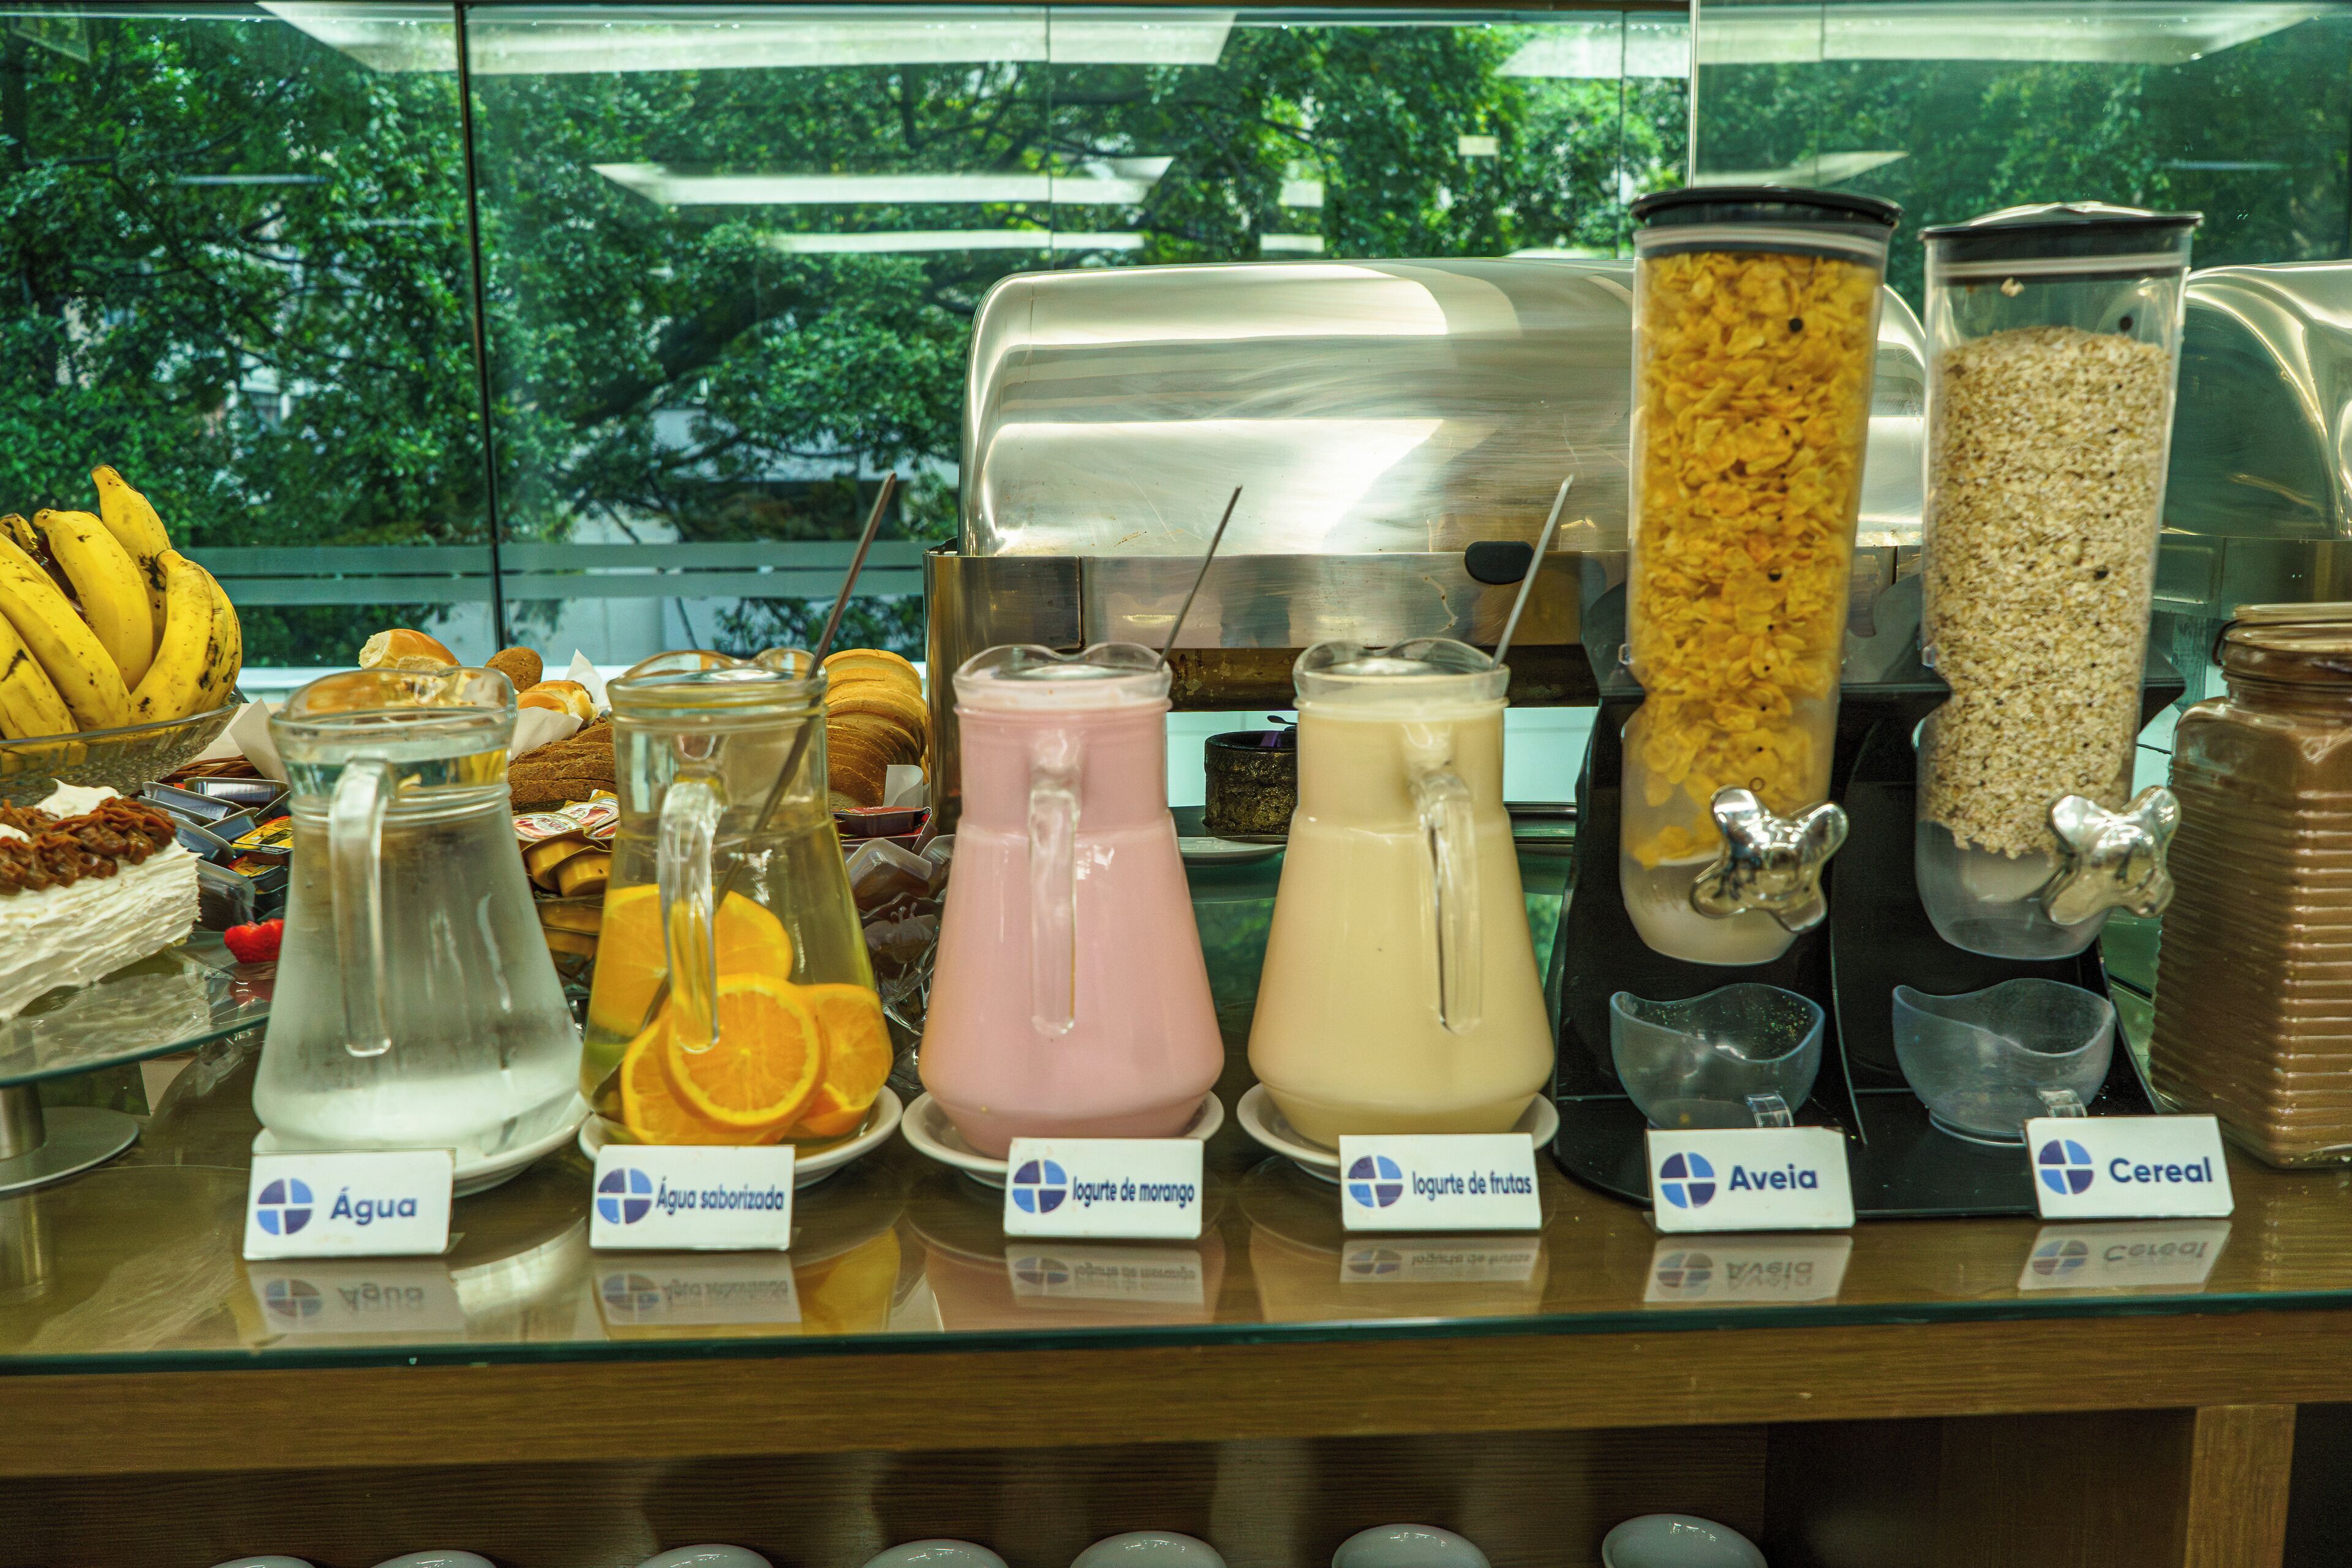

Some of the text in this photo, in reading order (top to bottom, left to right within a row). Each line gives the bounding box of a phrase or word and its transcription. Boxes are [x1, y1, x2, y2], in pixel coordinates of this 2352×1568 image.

[1412, 1170, 1533, 1202] Iogurte de frutas
[1727, 1162, 1819, 1192] Aveia
[2108, 1156, 2214, 1184] Cereal
[330, 1186, 418, 1226] Água
[656, 1176, 785, 1216] Água saborizada
[1072, 1175, 1196, 1210] Iogurte de morango
